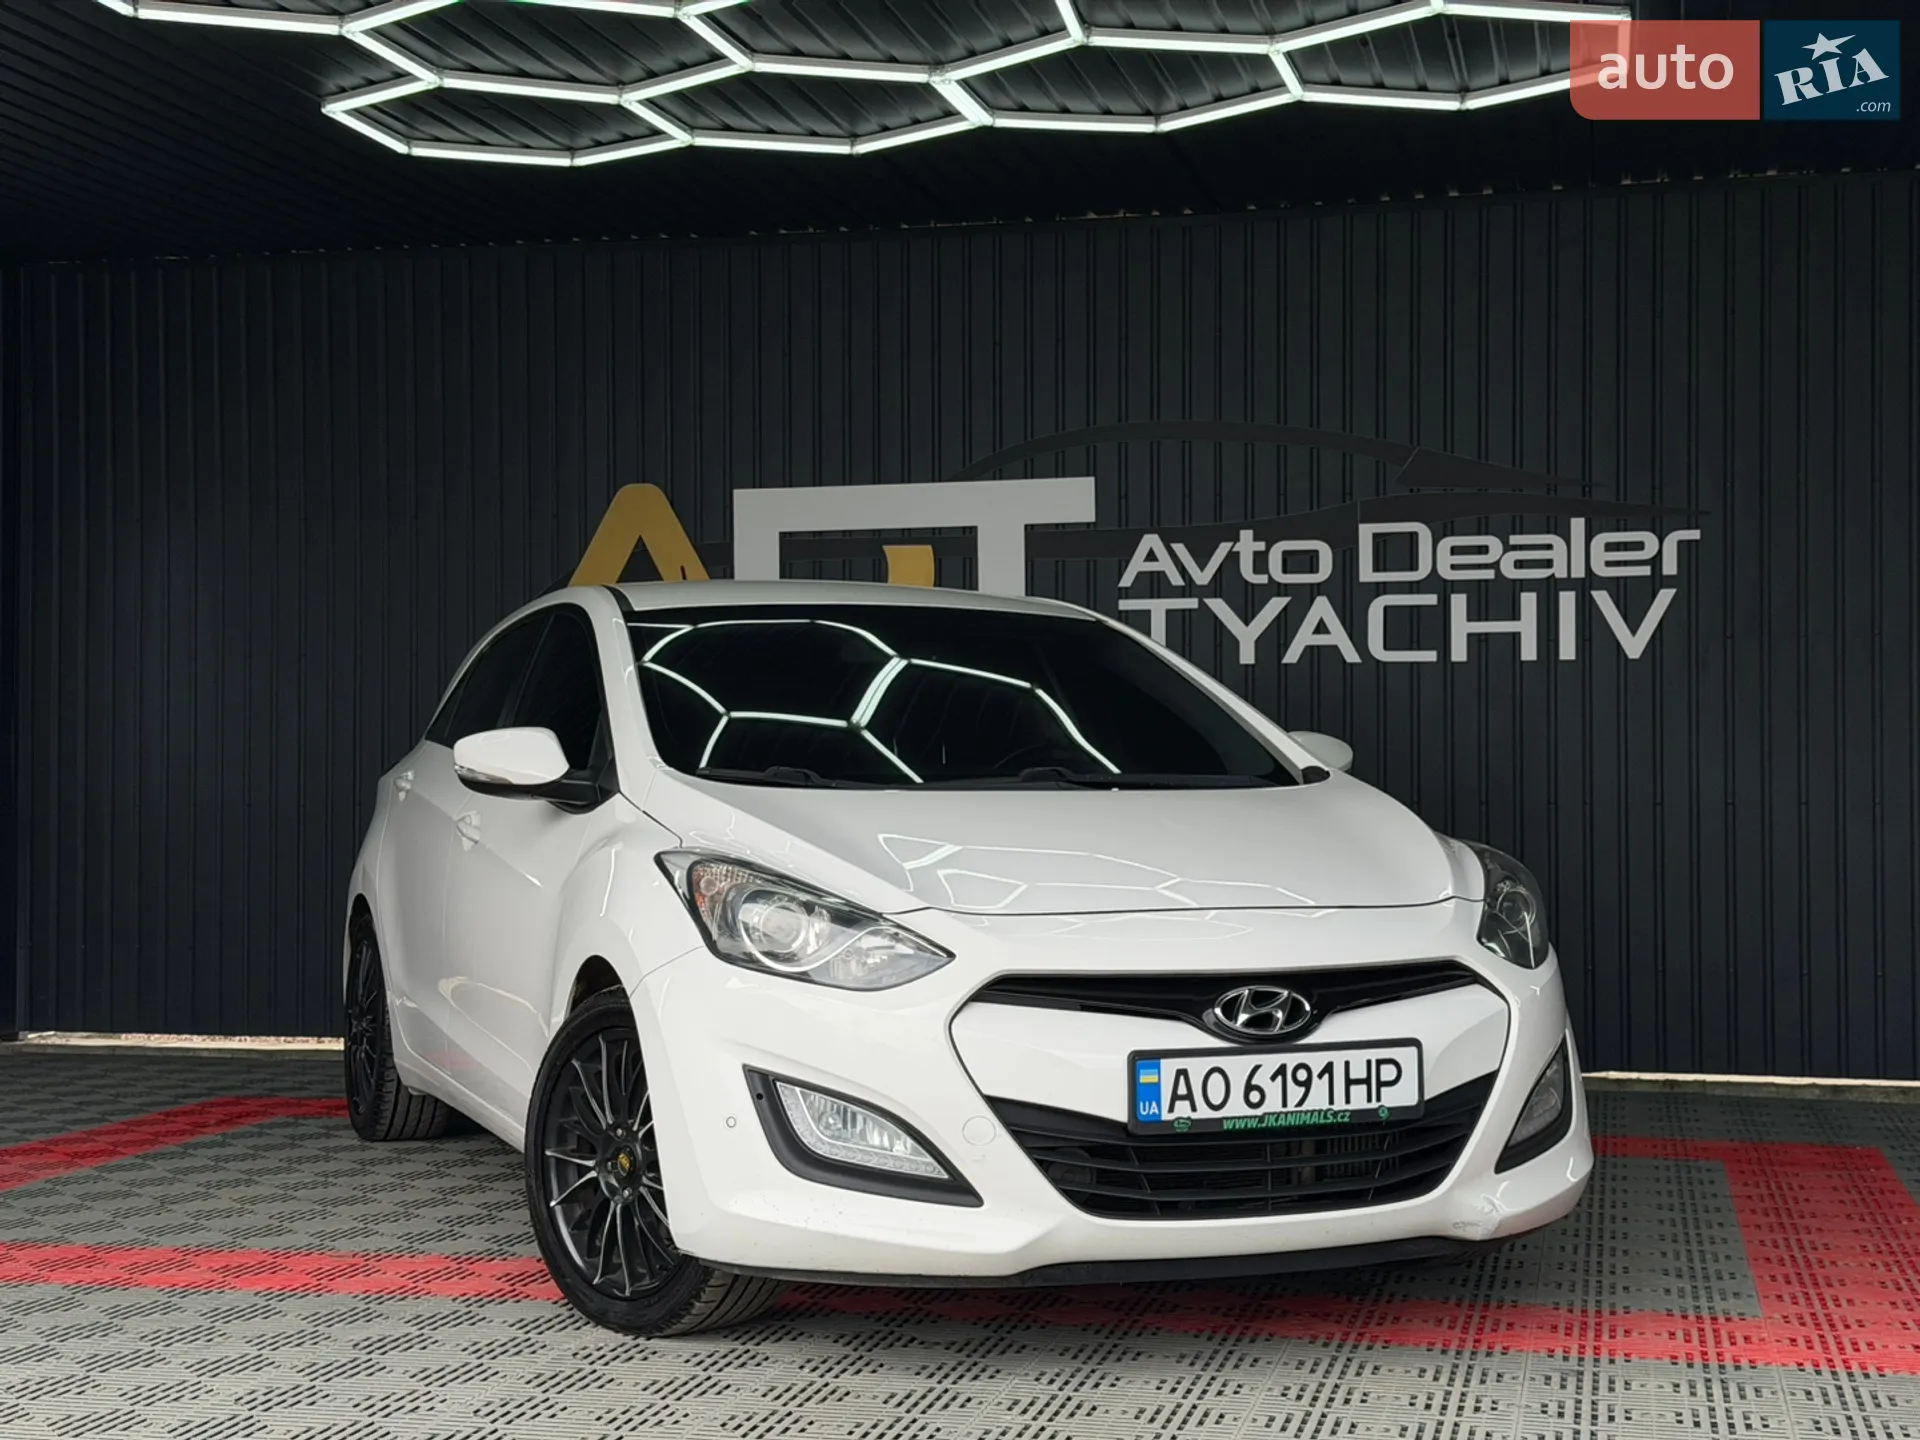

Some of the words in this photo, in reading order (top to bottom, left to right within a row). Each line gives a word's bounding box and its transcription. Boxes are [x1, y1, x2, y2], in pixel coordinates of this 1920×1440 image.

[1118, 529, 1333, 588] Avto
[1358, 517, 1701, 583] Dealer
[1118, 588, 1677, 665] TYACHIV
[1140, 1101, 1159, 1116] UA
